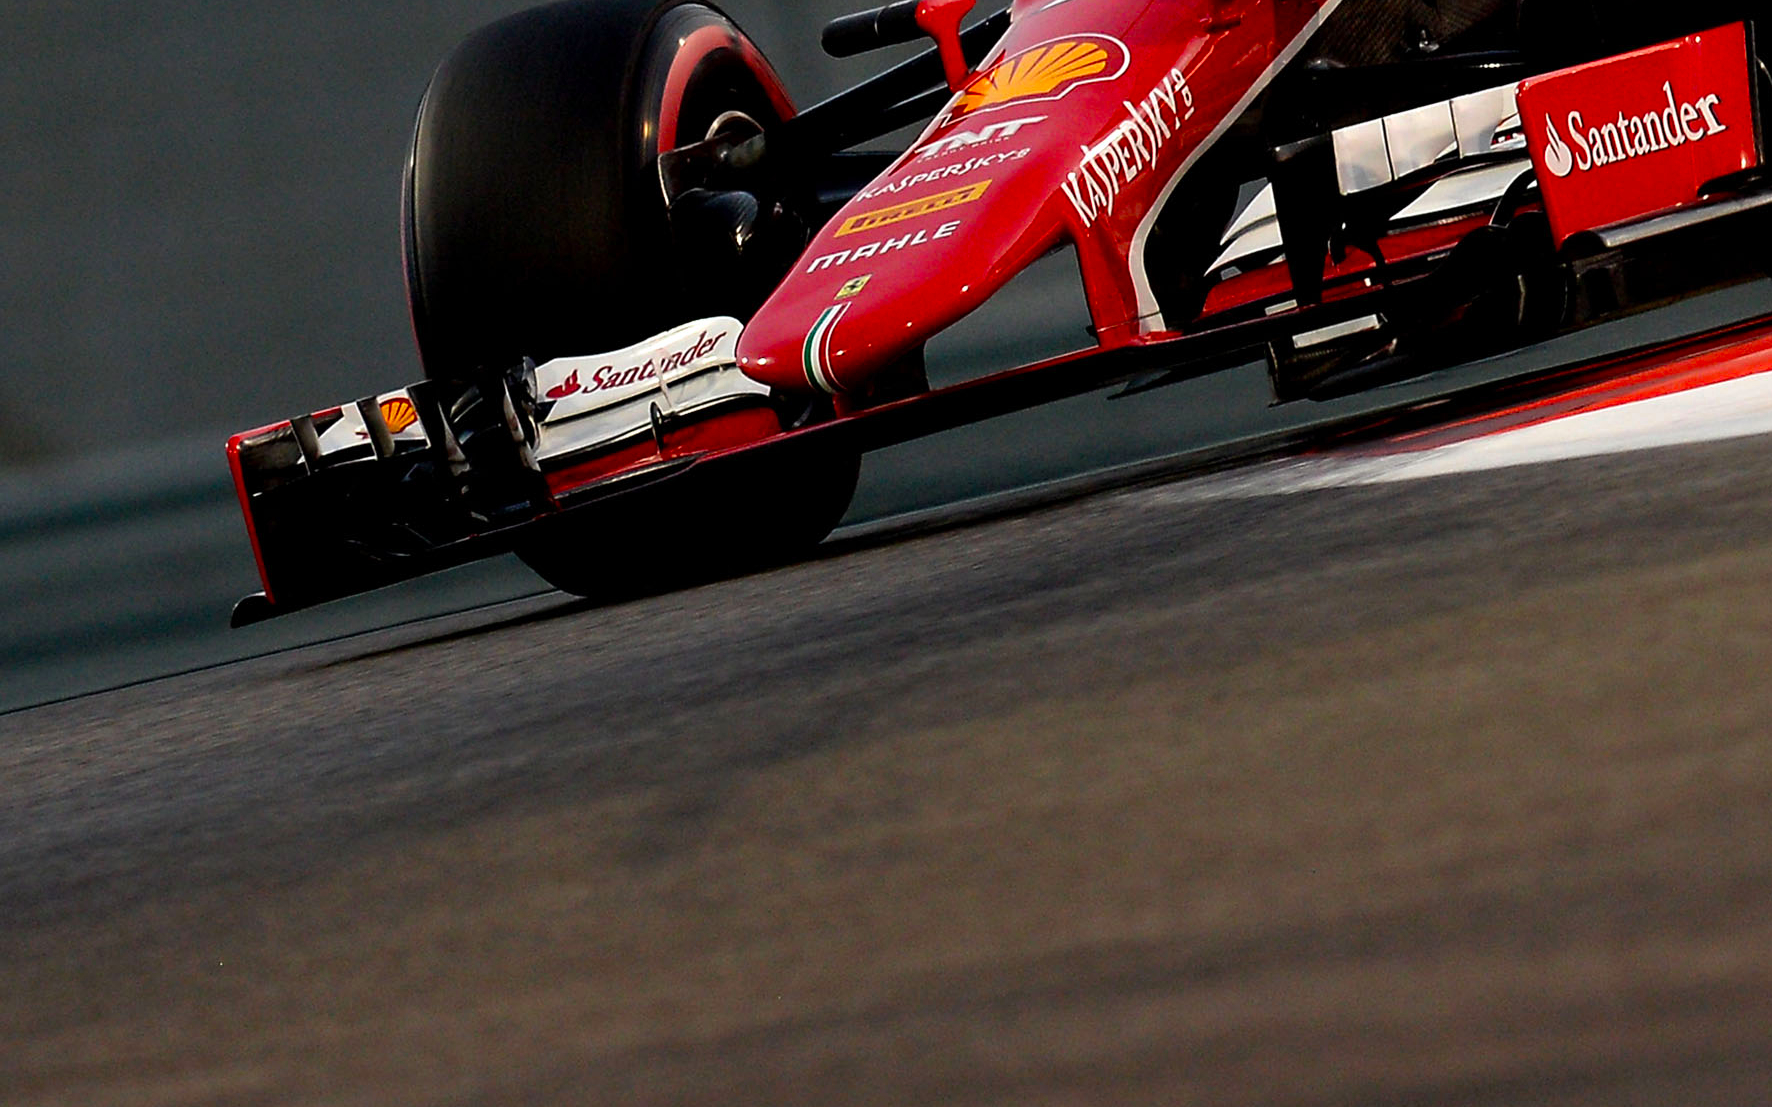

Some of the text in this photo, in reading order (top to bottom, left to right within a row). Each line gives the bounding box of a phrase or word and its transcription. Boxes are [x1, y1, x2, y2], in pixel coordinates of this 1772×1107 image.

[1060, 76, 1181, 228] KASPERSKY
[1567, 80, 1727, 171] Santander
[857, 149, 1017, 202] KASPERSKY
[806, 220, 961, 274] MAHLE
[582, 330, 727, 394] Santnder
